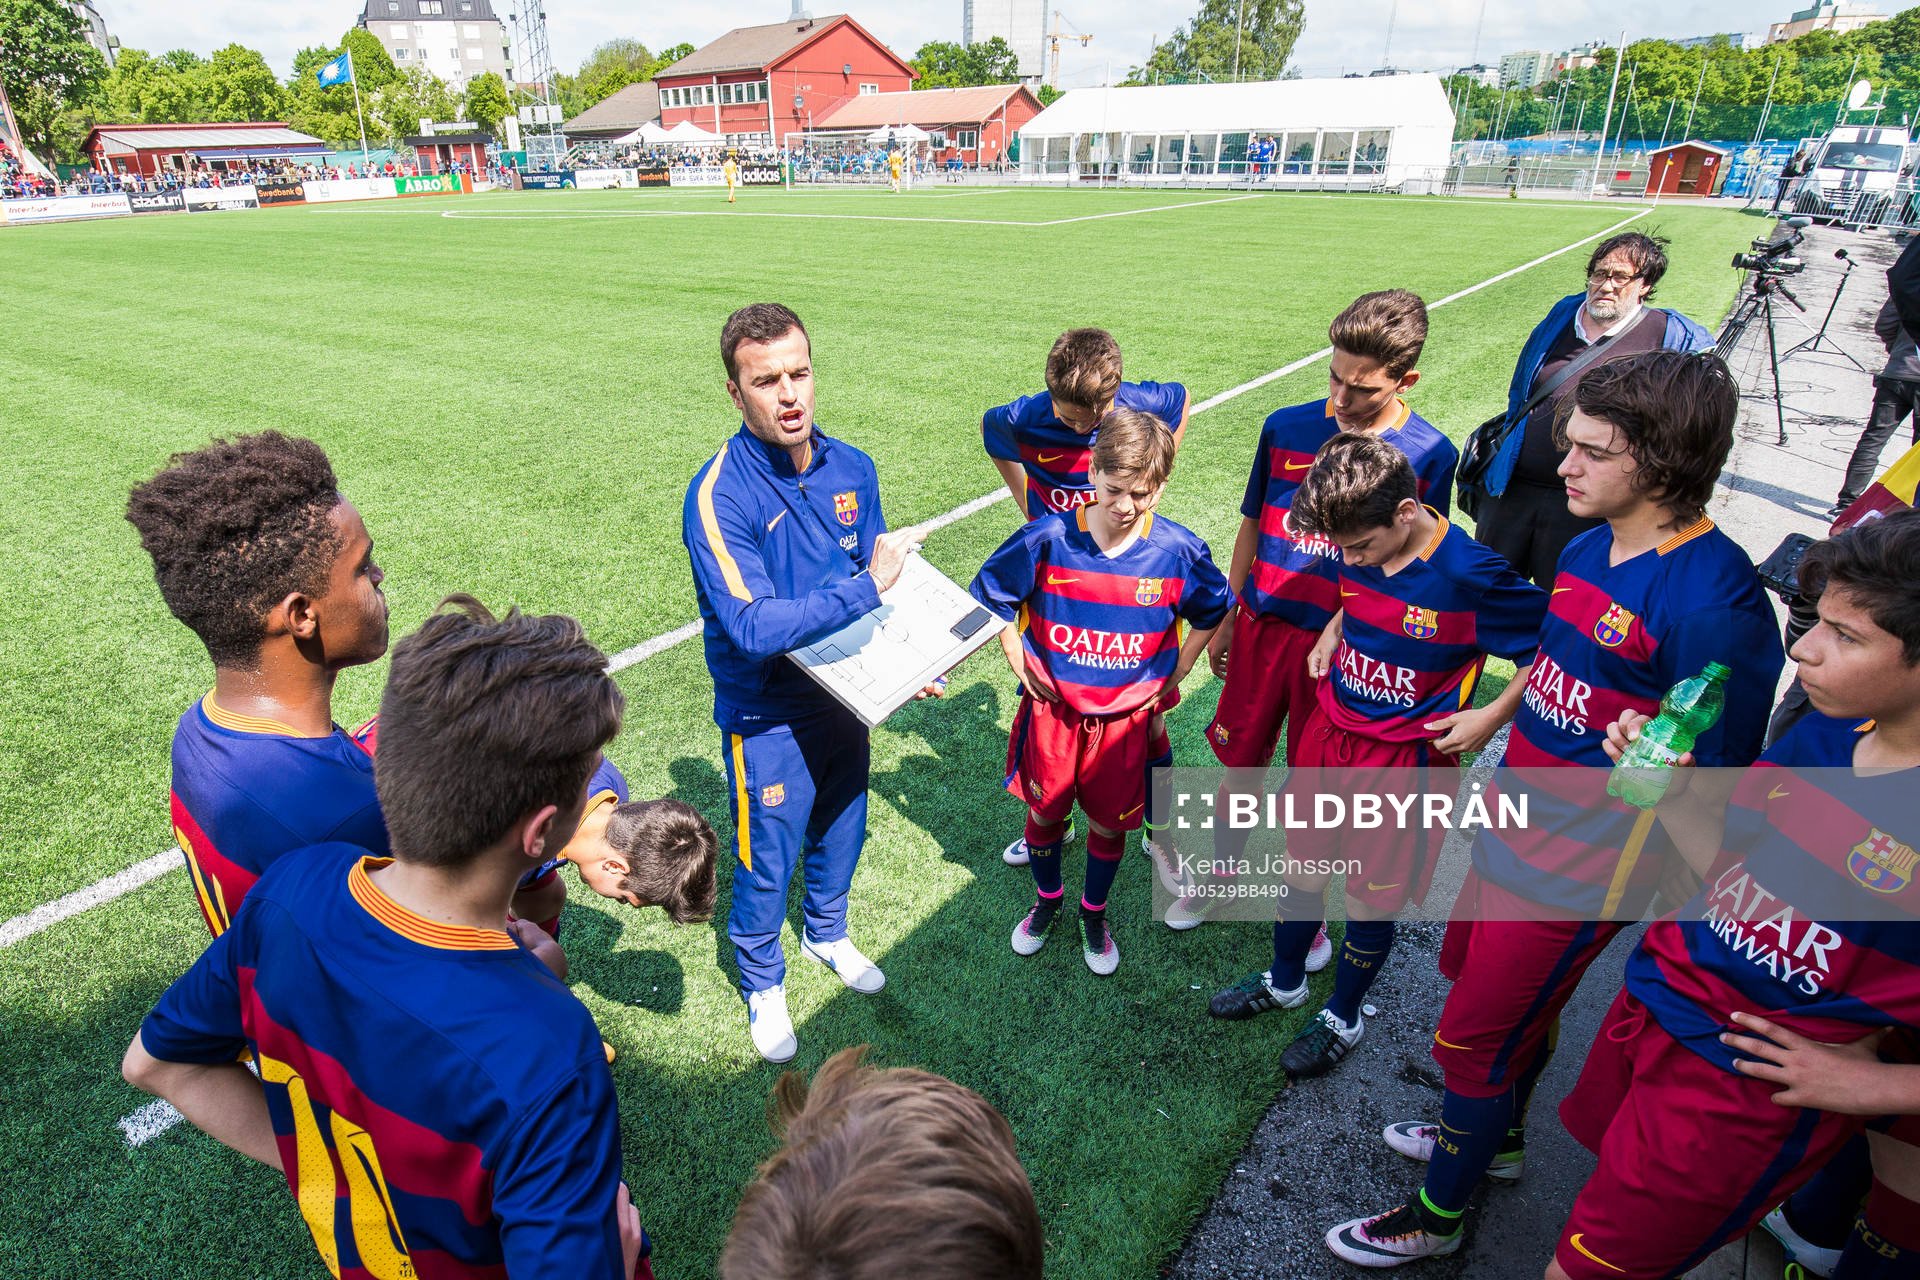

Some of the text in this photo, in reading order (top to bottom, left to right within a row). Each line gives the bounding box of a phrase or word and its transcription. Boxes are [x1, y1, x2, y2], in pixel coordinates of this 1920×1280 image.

[743, 166, 780, 182] adidas
[132, 193, 182, 208] stadium
[258, 186, 295, 198] Swedbank
[9, 206, 48, 214] Interbus
[91, 200, 127, 208] Interbus
[1051, 488, 1097, 512] QAT
[1293, 538, 1339, 562] AIRW
[1049, 624, 1144, 655] QATAR
[1068, 650, 1141, 670] AIRWAYS
[1340, 671, 1415, 708] AIRWAYS
[1526, 652, 1592, 717] ATAR
[1522, 683, 1588, 735] AIRWAYS
[1701, 903, 1825, 995] AIRWAYS
[1344, 952, 1373, 969] FCB
[1438, 1135, 1460, 1155] CB
[1855, 1218, 1900, 1259] FCB
